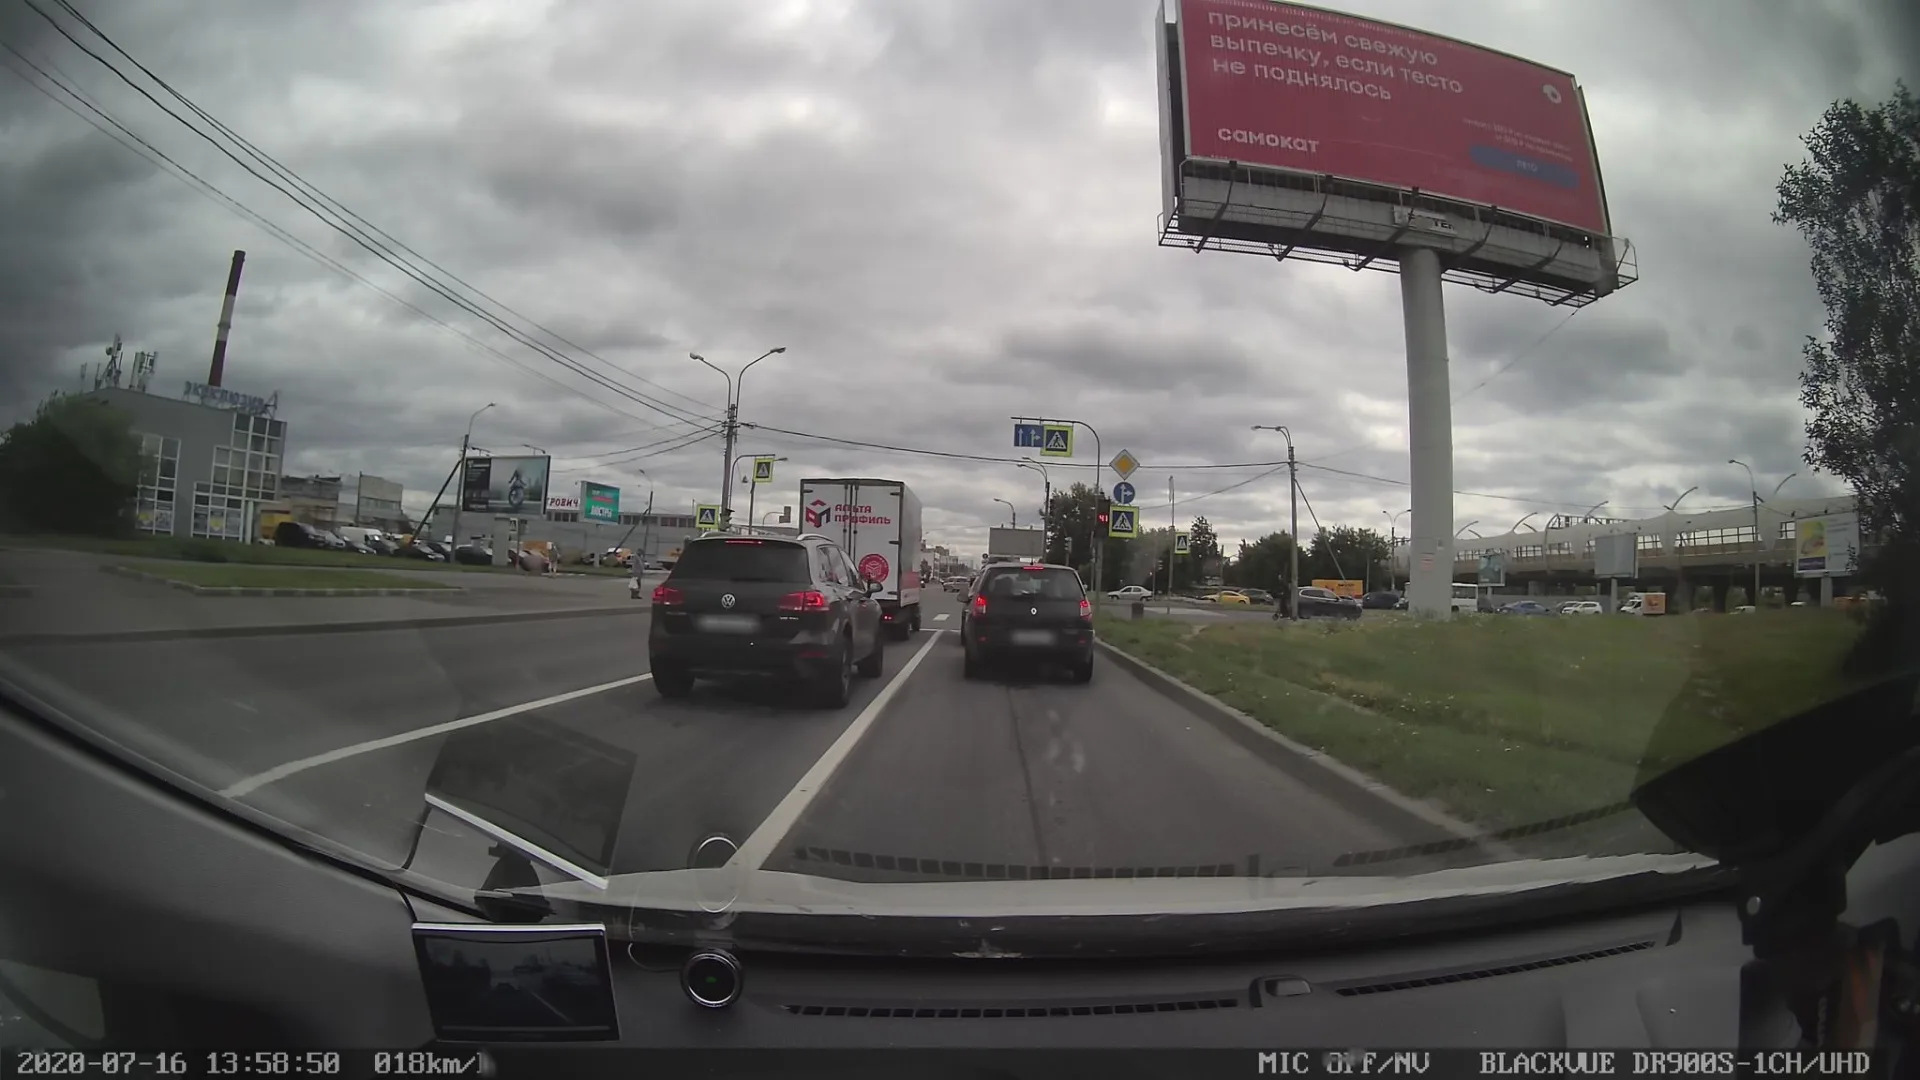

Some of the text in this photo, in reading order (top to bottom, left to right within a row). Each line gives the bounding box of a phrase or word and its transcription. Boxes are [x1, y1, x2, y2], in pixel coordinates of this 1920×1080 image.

[1208, 12, 1438, 65] принесём свежую
[1210, 34, 1463, 94] выпечку, если тесто
[1213, 58, 1392, 101] не поднялось
[1217, 128, 1319, 153] самокат
[547, 497, 579, 508] РОВИЧ
[834, 504, 872, 514] АЛЬТА
[834, 514, 892, 525] ПРОФИЛЬ
